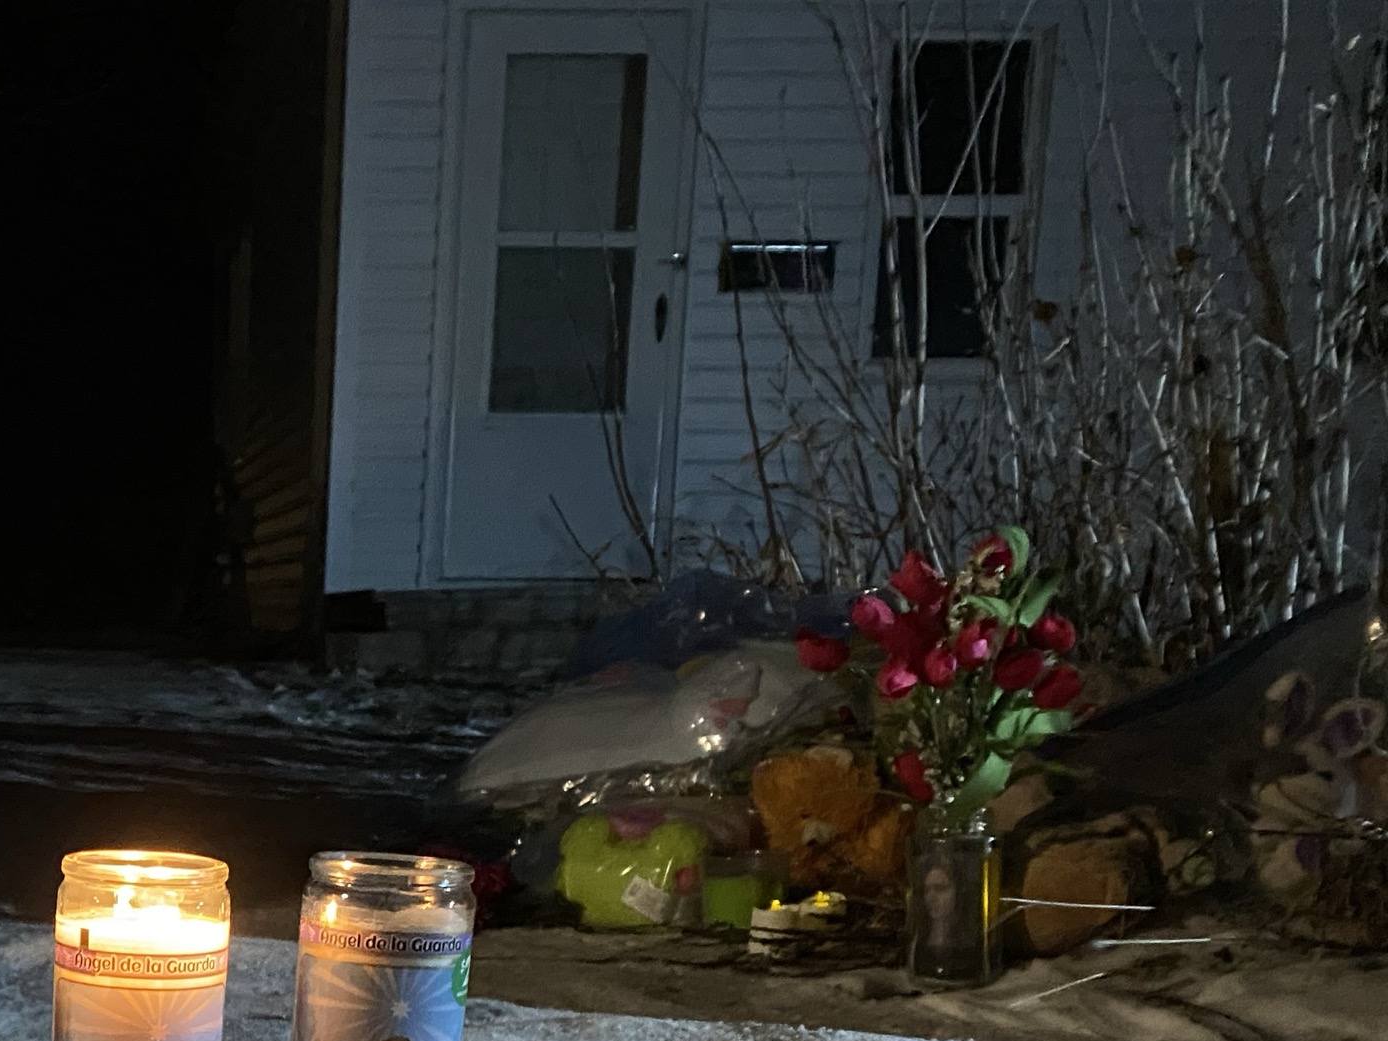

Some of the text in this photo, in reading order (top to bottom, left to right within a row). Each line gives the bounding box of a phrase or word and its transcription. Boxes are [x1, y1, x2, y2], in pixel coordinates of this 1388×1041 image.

[366, 934, 386, 949] de
[392, 935, 406, 950] la
[412, 937, 462, 951] Guarda
[75, 949, 215, 973] Ángel de la Guarda
